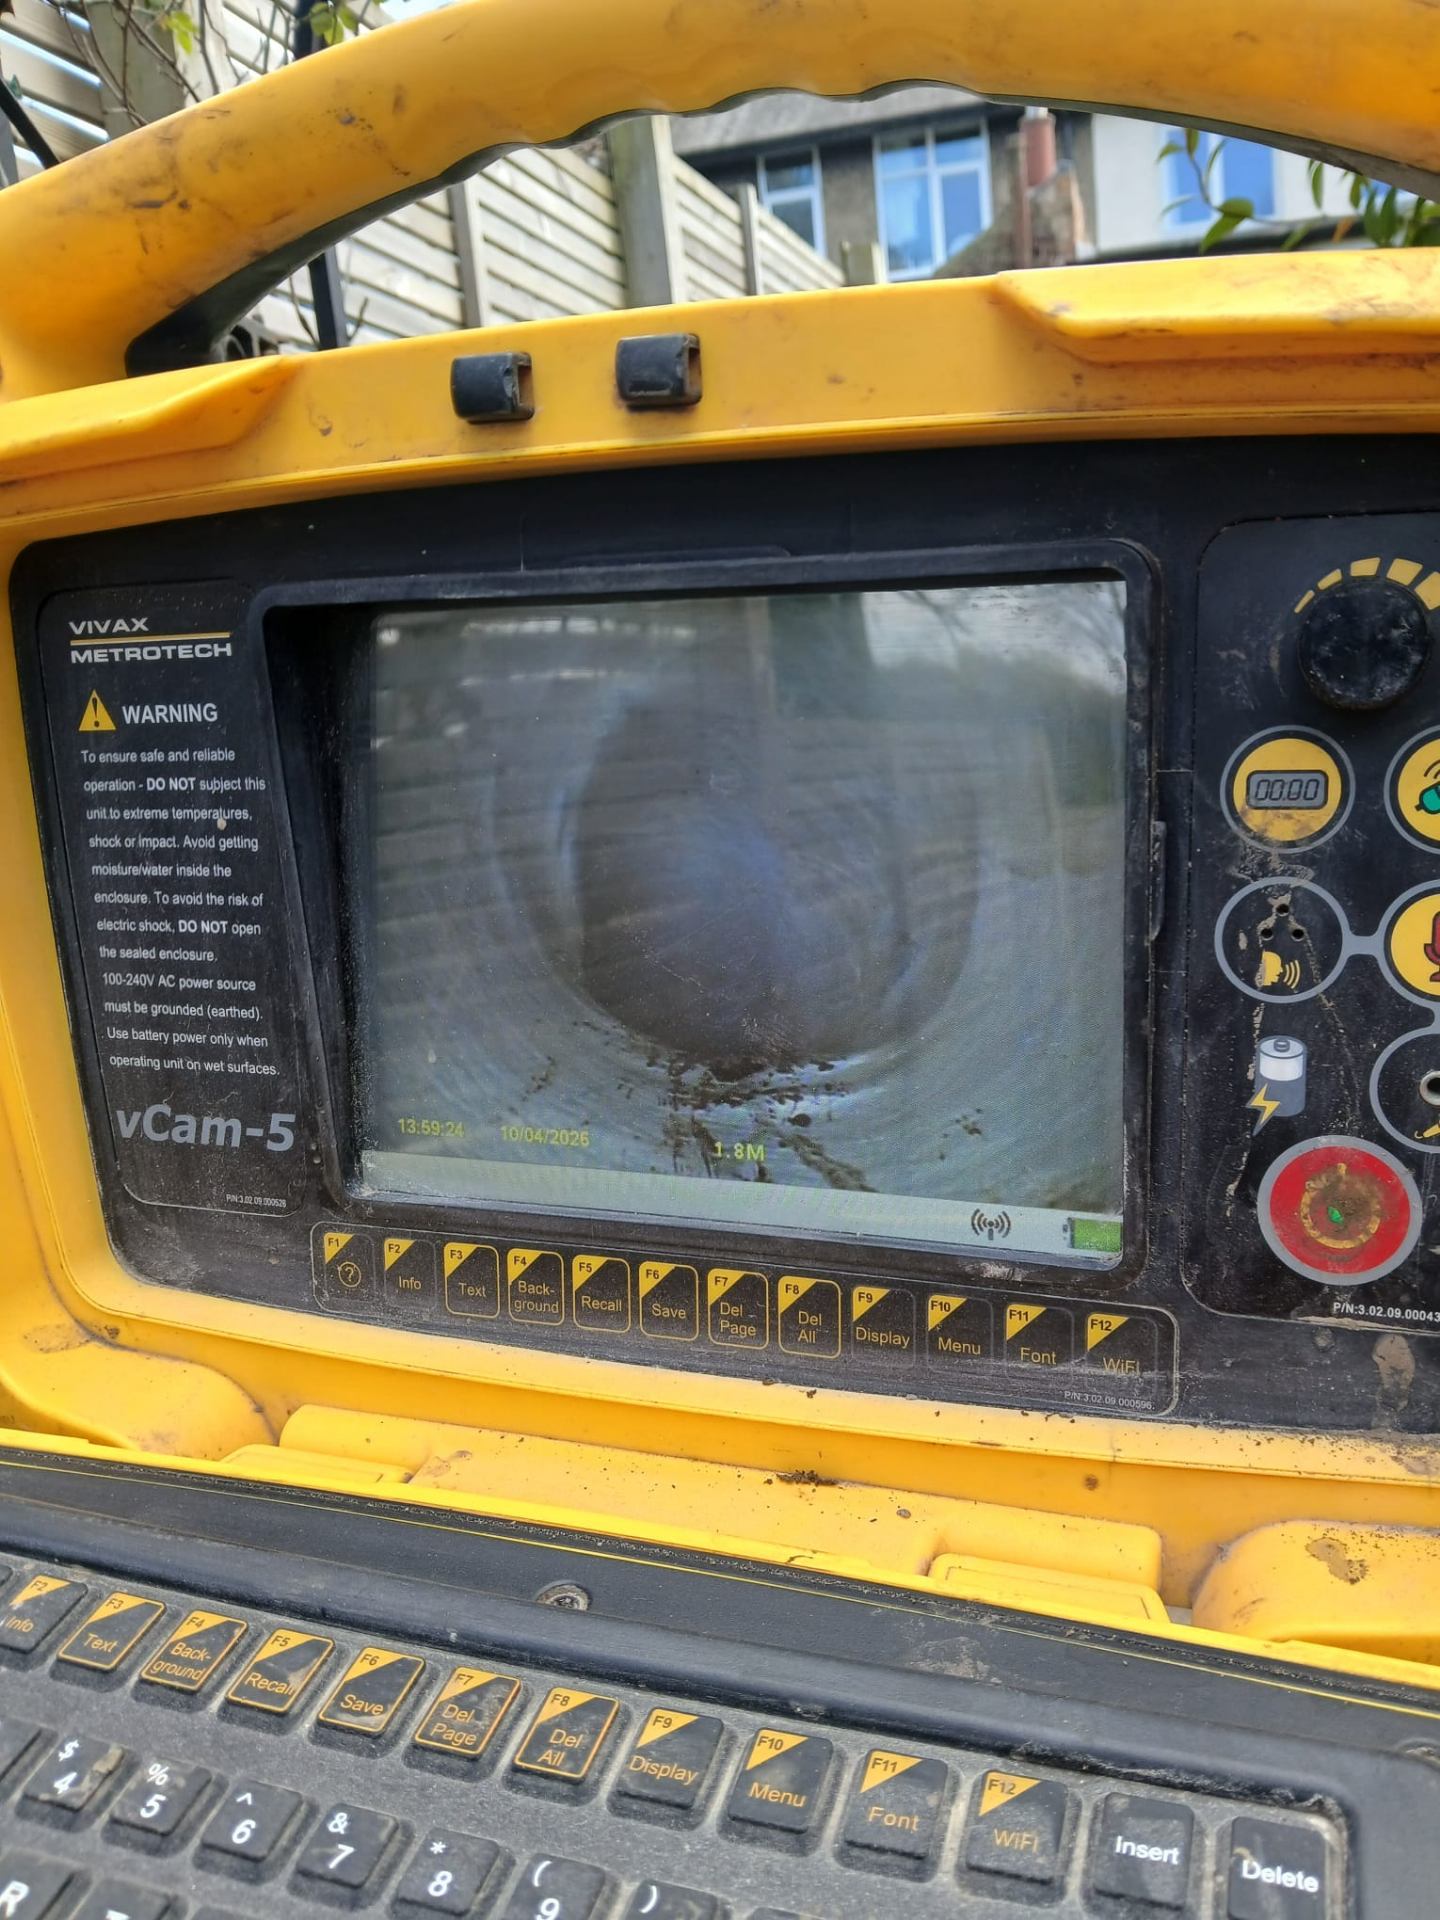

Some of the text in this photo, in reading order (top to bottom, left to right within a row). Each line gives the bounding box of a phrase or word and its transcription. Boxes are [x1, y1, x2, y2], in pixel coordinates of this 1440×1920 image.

[68, 617, 150, 635] VIVAX
[70, 643, 233, 664] METROTECH
[122, 702, 219, 725] WARNING
[81, 747, 236, 763] To ensure safe and reliable
[83, 779, 136, 796] operation
[146, 778, 166, 791] DO
[169, 778, 196, 791] NOT
[199, 777, 242, 794] subject
[244, 776, 267, 791] this
[86, 806, 253, 823] unit to extreme temperatures,
[88, 834, 260, 851] shock or impact. Avoid getting
[91, 863, 232, 878] moisture/water inside the
[94, 891, 264, 907] enclosure. To avoid the risk of
[96, 918, 262, 937] electric shock, DO NOT open
[99, 946, 219, 963] the sealed enclosure.
[102, 972, 257, 992] 100-240V AC power source
[104, 1001, 264, 1021] must be grounded (earthed).
[107, 1027, 269, 1048] Use battery power only when
[109, 1055, 281, 1076] operating unit on wet surfaces.
[115, 1103, 298, 1153] vCam-5
[397, 1117, 465, 1138] 13:59:24
[500, 1125, 590, 1148] 10/04/2026
[713, 1141, 766, 1162] 1.8M
[327, 1237, 341, 1248] F1
[387, 1242, 402, 1255] F2
[449, 1248, 464, 1261] F3
[513, 1255, 528, 1267] F4
[578, 1262, 593, 1274] F5
[645, 1269, 660, 1281] F6
[397, 1275, 422, 1291] Info
[458, 1282, 486, 1298] Text
[518, 1281, 555, 1296] Back-
[714, 1276, 728, 1287] F7
[785, 1284, 800, 1295] F8
[513, 1299, 559, 1315] ground
[581, 1295, 623, 1313] Recall
[858, 1292, 873, 1305] F9
[931, 1301, 951, 1314] F10
[651, 1303, 687, 1319] Save
[720, 1301, 743, 1317] Del
[1009, 1309, 1030, 1322] F11
[798, 1311, 823, 1327] Del
[1090, 1319, 1112, 1332] F12
[720, 1320, 757, 1339] Page
[798, 1329, 817, 1345] All
[855, 1327, 911, 1349] Display
[938, 1337, 982, 1356] Menu
[1020, 1347, 1057, 1366] Font
[31, 1580, 48, 1592] F2
[106, 1597, 123, 1610] F3
[5, 1616, 34, 1633] Info
[186, 1616, 204, 1629] F4
[84, 1633, 118, 1653] Text
[270, 1634, 290, 1647] F5
[170, 1642, 213, 1662] Back-
[360, 1653, 379, 1666] F6
[151, 1660, 206, 1681] ground
[455, 1672, 474, 1686] F7
[245, 1673, 296, 1696] Recall
[340, 1694, 384, 1716] Save
[552, 1693, 570, 1707] F8
[442, 1704, 476, 1723] Del
[652, 1715, 673, 1729] F9
[430, 1724, 477, 1746] Page
[549, 1729, 584, 1748] Del
[757, 1735, 784, 1751] F10
[59, 1740, 81, 1762] $
[537, 1752, 564, 1767] All
[629, 1755, 698, 1784] Display
[870, 1757, 898, 1773] F11
[54, 1771, 77, 1795] 4
[148, 1763, 169, 1786] %
[749, 1782, 808, 1808] Menu
[987, 1778, 1017, 1795] F12
[140, 1795, 167, 1819] 5
[327, 1812, 349, 1834] &
[868, 1806, 920, 1834] Font
[231, 1819, 257, 1844] 6
[327, 1844, 355, 1870] 7
[1115, 1835, 1180, 1866] Insert
[427, 1870, 453, 1897] 8
[1241, 1858, 1320, 1894] Delete
[0, 1880, 30, 1918] R
[535, 1898, 561, 1920] 9
